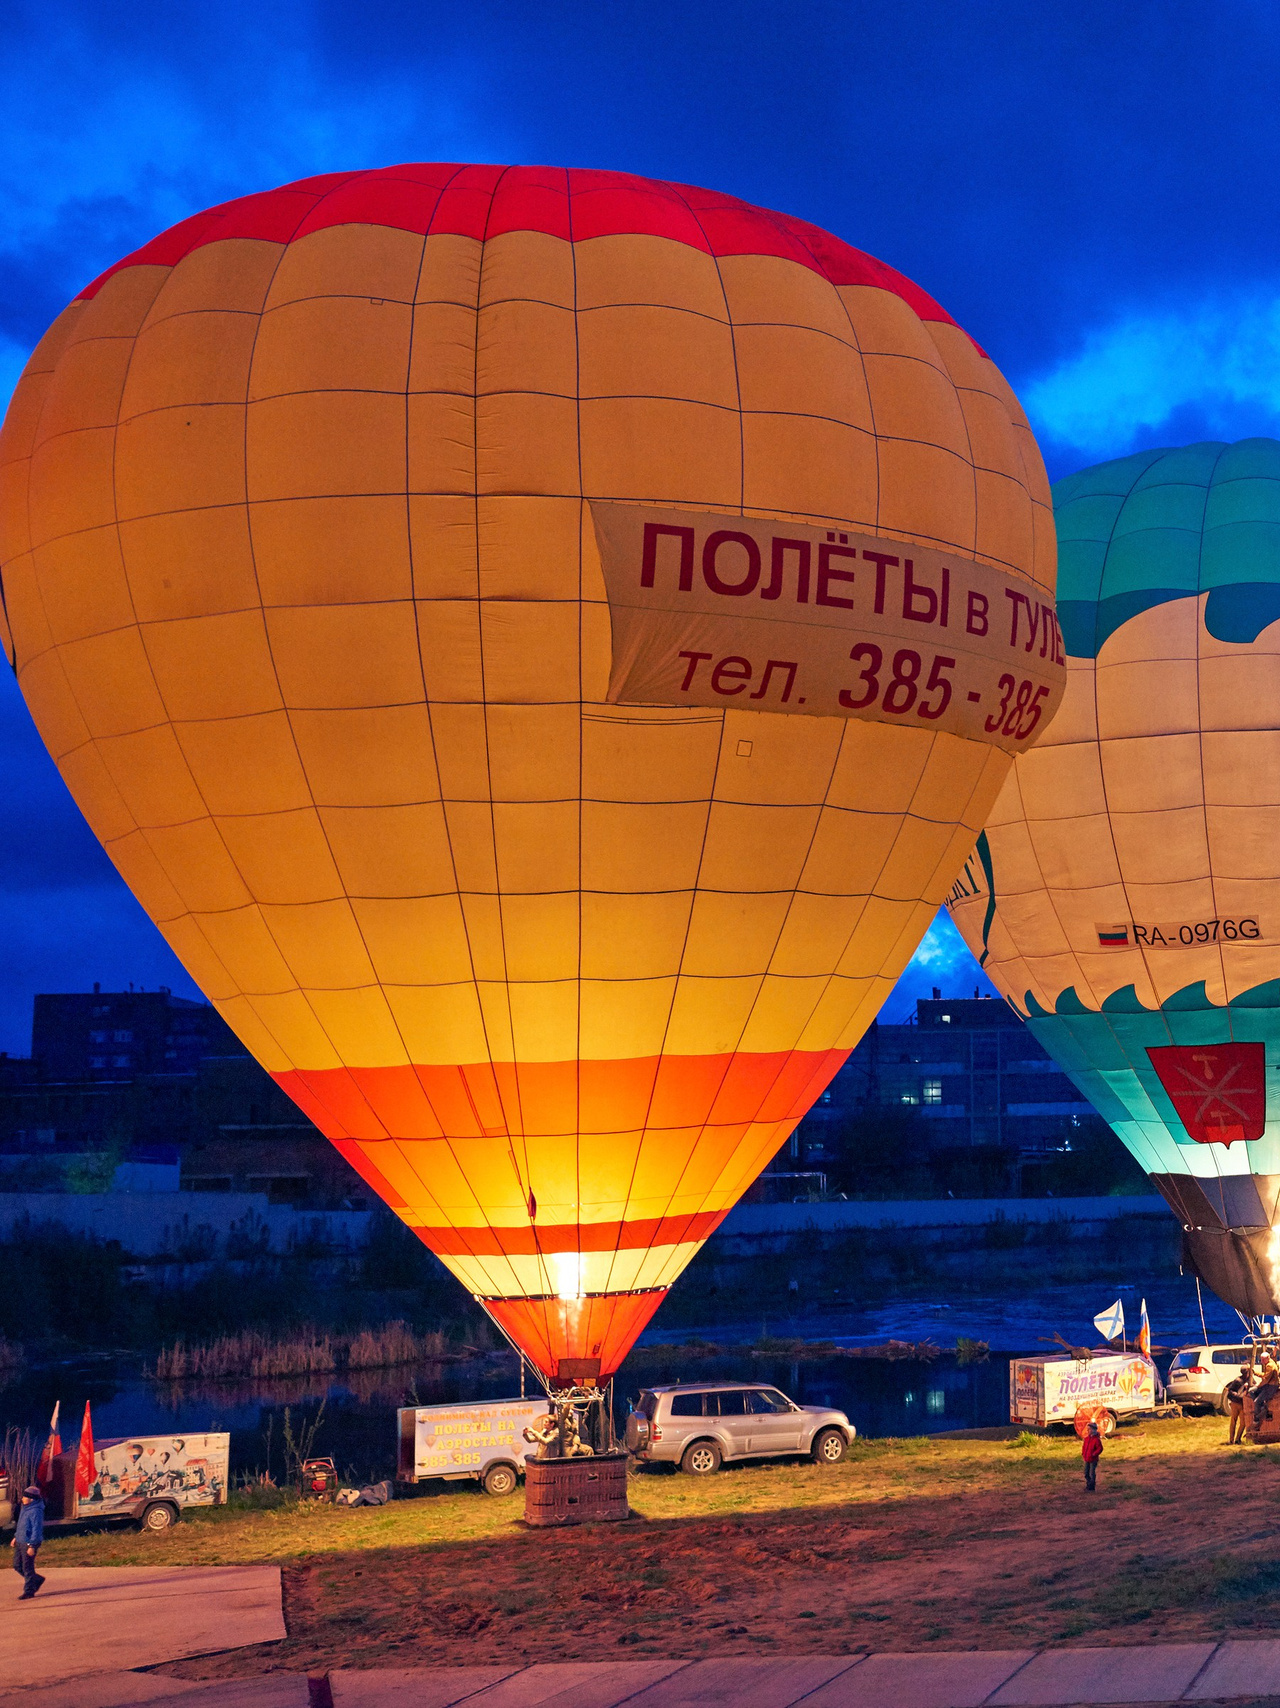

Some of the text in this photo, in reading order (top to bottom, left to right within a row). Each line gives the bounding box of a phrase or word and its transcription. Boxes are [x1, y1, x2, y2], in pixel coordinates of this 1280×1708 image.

[640, 522, 950, 627] ПОЛЁТЫ
[1005, 587, 1065, 667] ТУЛЕ
[678, 650, 807, 704] тел.
[1133, 919, 1260, 946] RA-0976G
[1059, 1371, 1118, 1394] ПОЛЁТЫ
[435, 1420, 515, 1435] ПОЛЕТЫ НА
[437, 1435, 513, 1450] АЭРОСТАТЕ
[421, 1453, 480, 1468] 385-385
